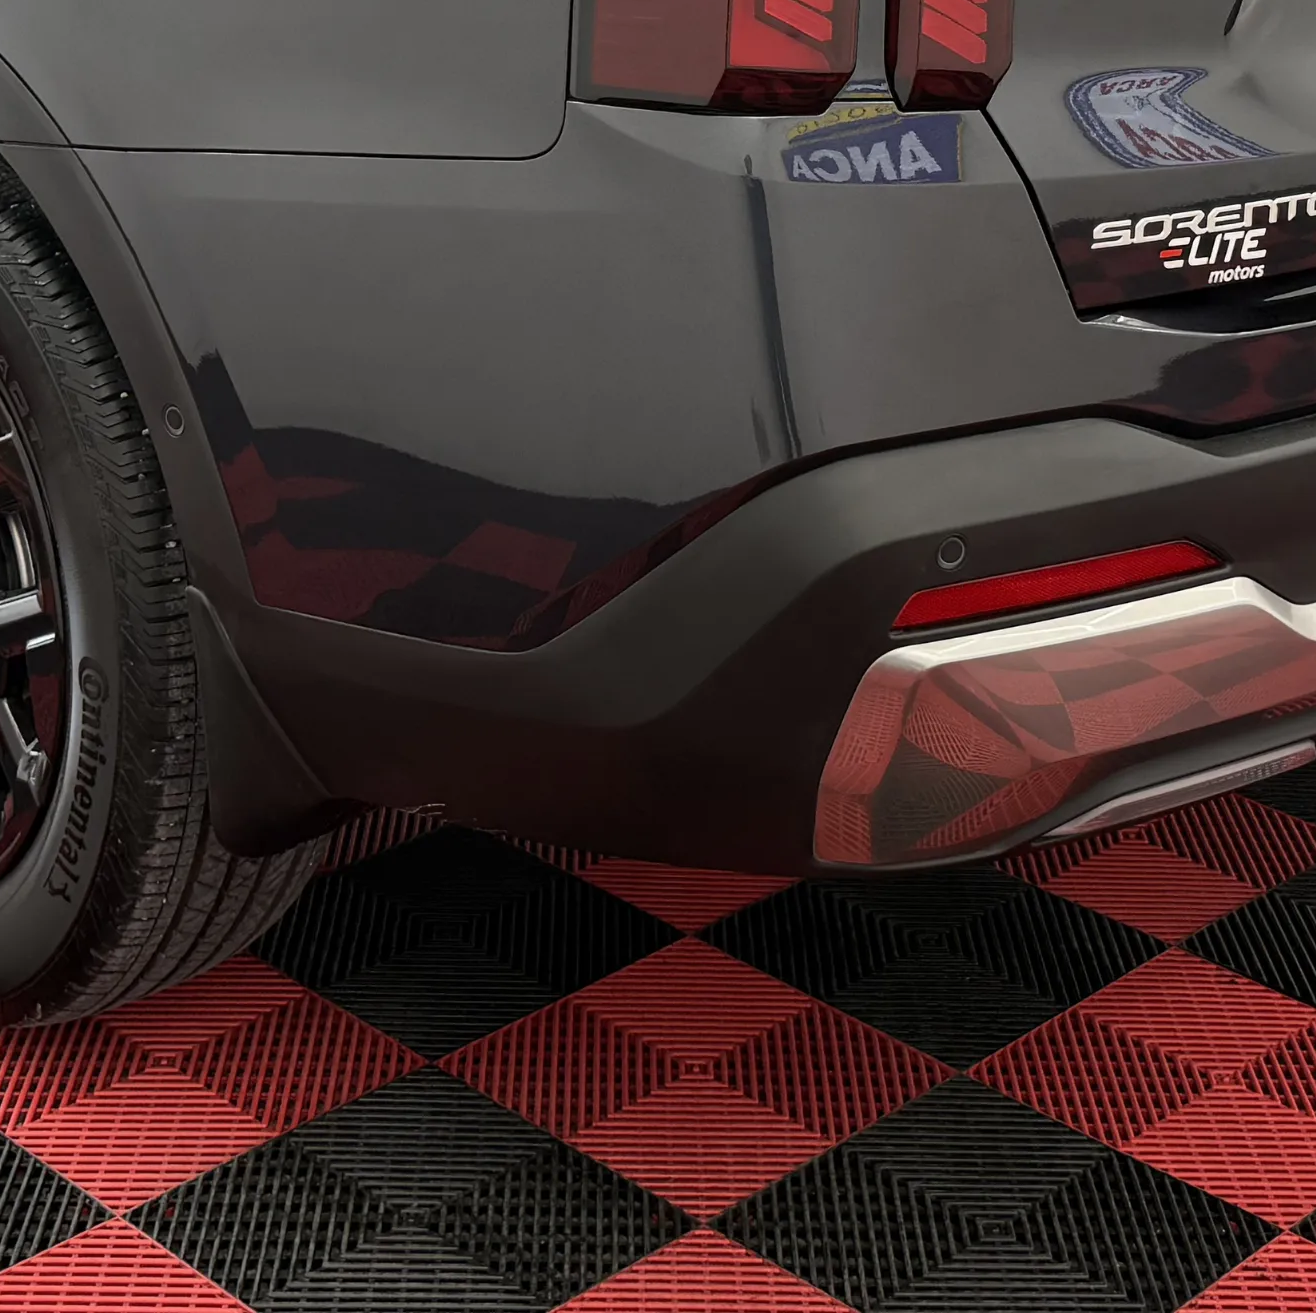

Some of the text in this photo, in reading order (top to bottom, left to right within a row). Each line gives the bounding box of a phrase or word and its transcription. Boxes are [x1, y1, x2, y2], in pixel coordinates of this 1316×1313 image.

[1159, 228, 1267, 269] ELITE
[1207, 264, 1265, 285] motors
[54, 655, 110, 886] Continental
